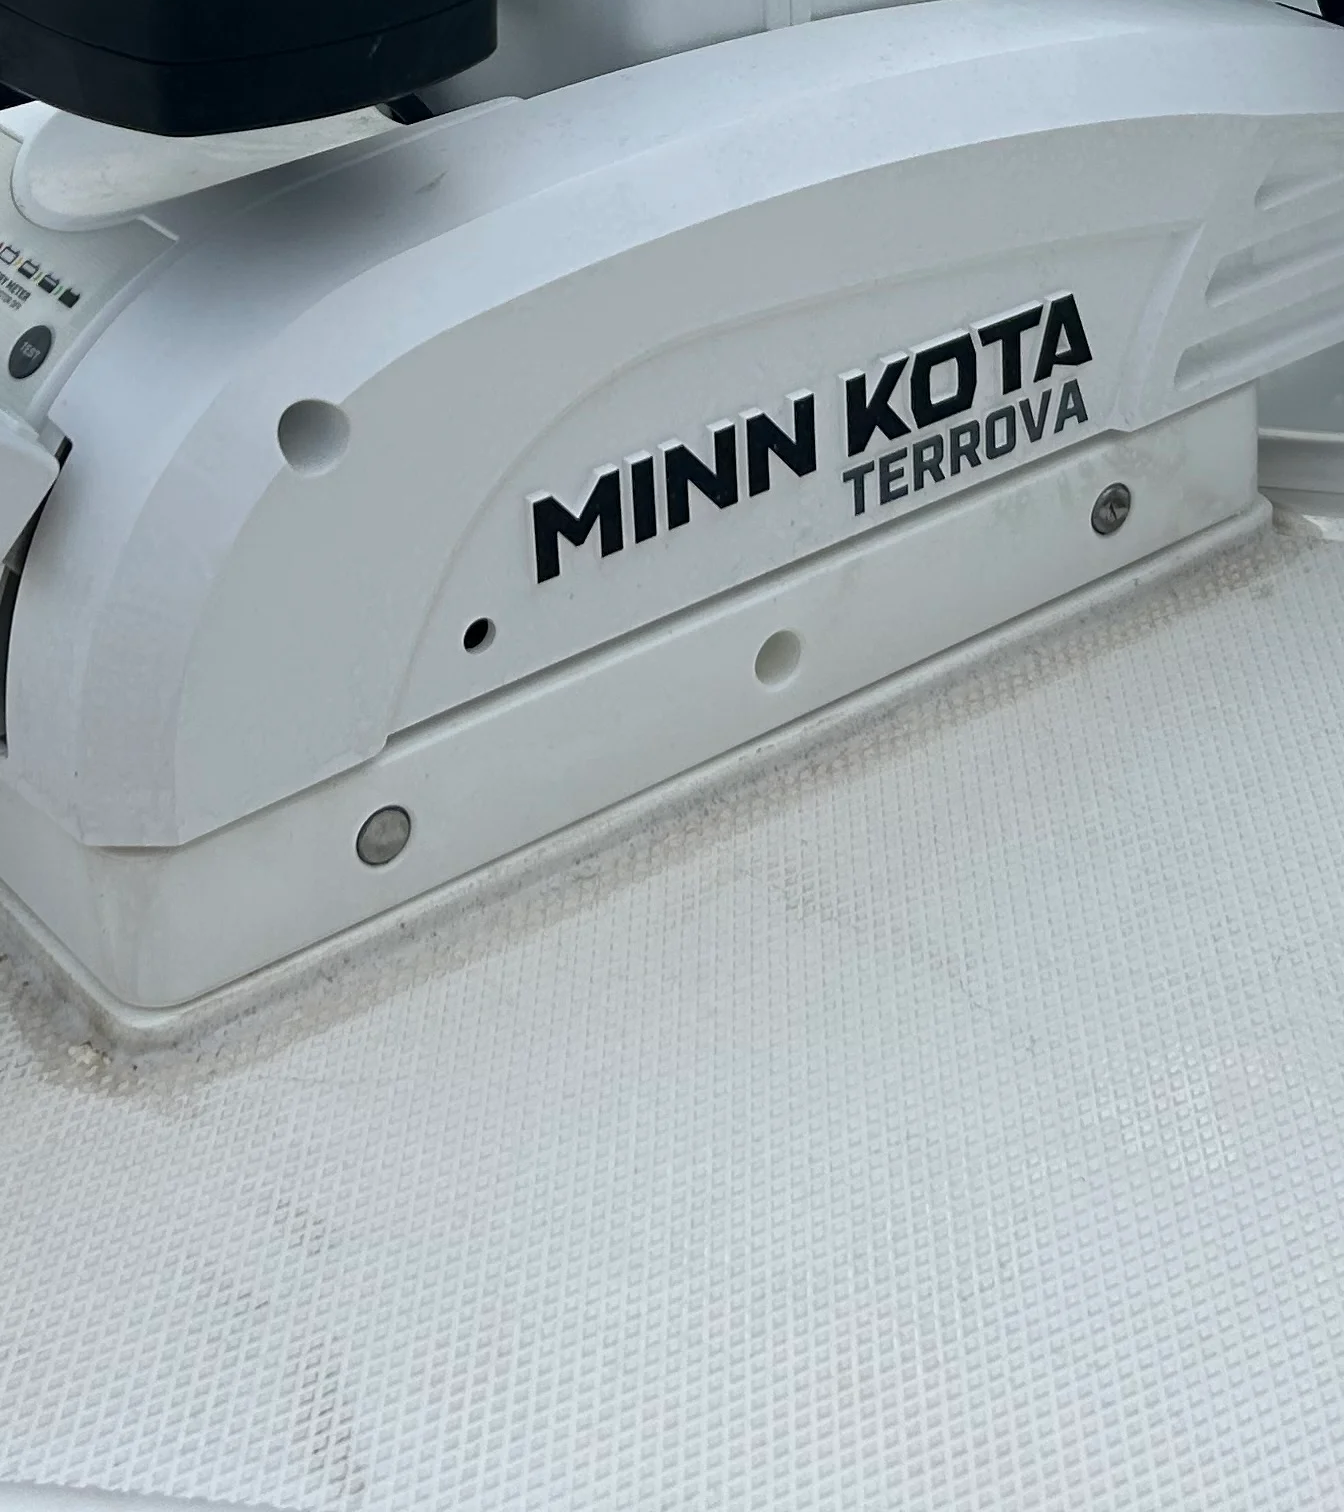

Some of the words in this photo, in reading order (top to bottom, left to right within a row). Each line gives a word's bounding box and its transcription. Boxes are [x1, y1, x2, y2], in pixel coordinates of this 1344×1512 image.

[5, 280, 31, 302] METER
[20, 341, 41, 360] TEST
[528, 389, 817, 584] MINN
[841, 291, 1093, 457] KOTA
[842, 378, 1089, 517] TERROVA
